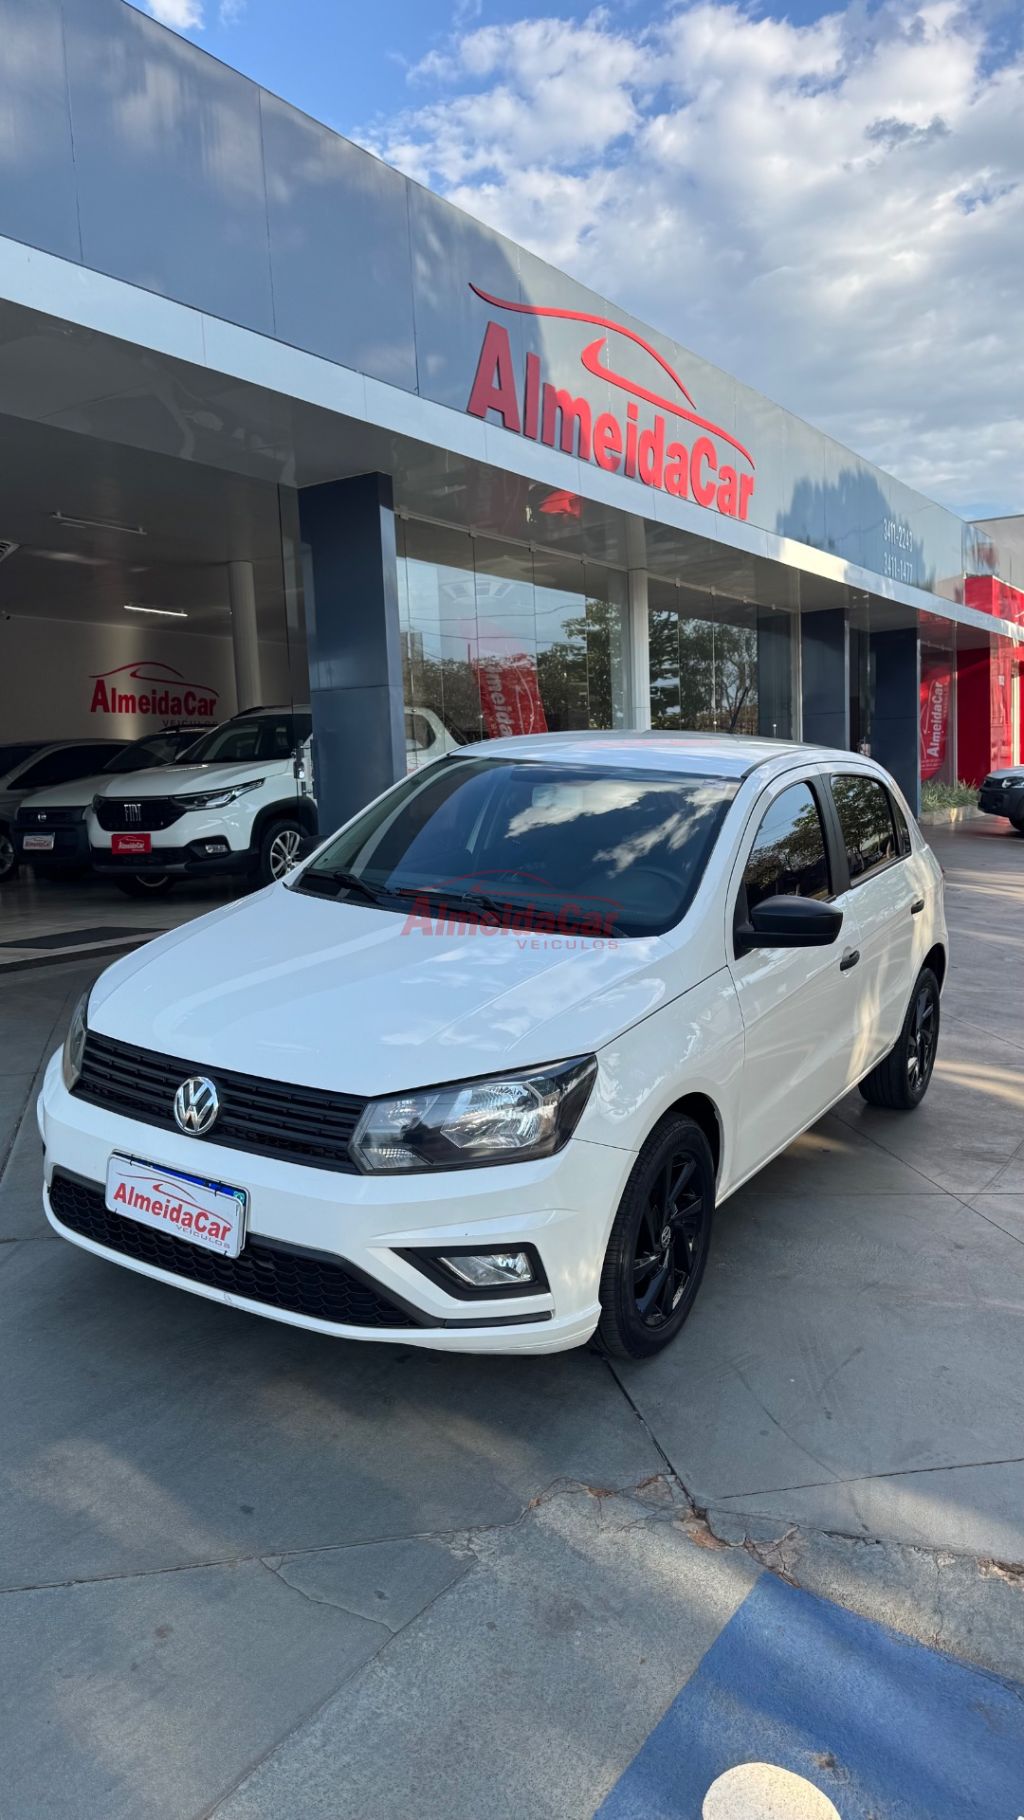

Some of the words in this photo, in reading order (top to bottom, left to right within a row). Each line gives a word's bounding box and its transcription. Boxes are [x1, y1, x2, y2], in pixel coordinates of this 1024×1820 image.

[466, 320, 754, 521] AlmeidaCar
[90, 679, 217, 717] AlmeidaCar
[927, 682, 944, 758] AlmeidaCar
[113, 1183, 232, 1241] AlmeidaCar
[176, 1224, 231, 1249] VEICULOS
